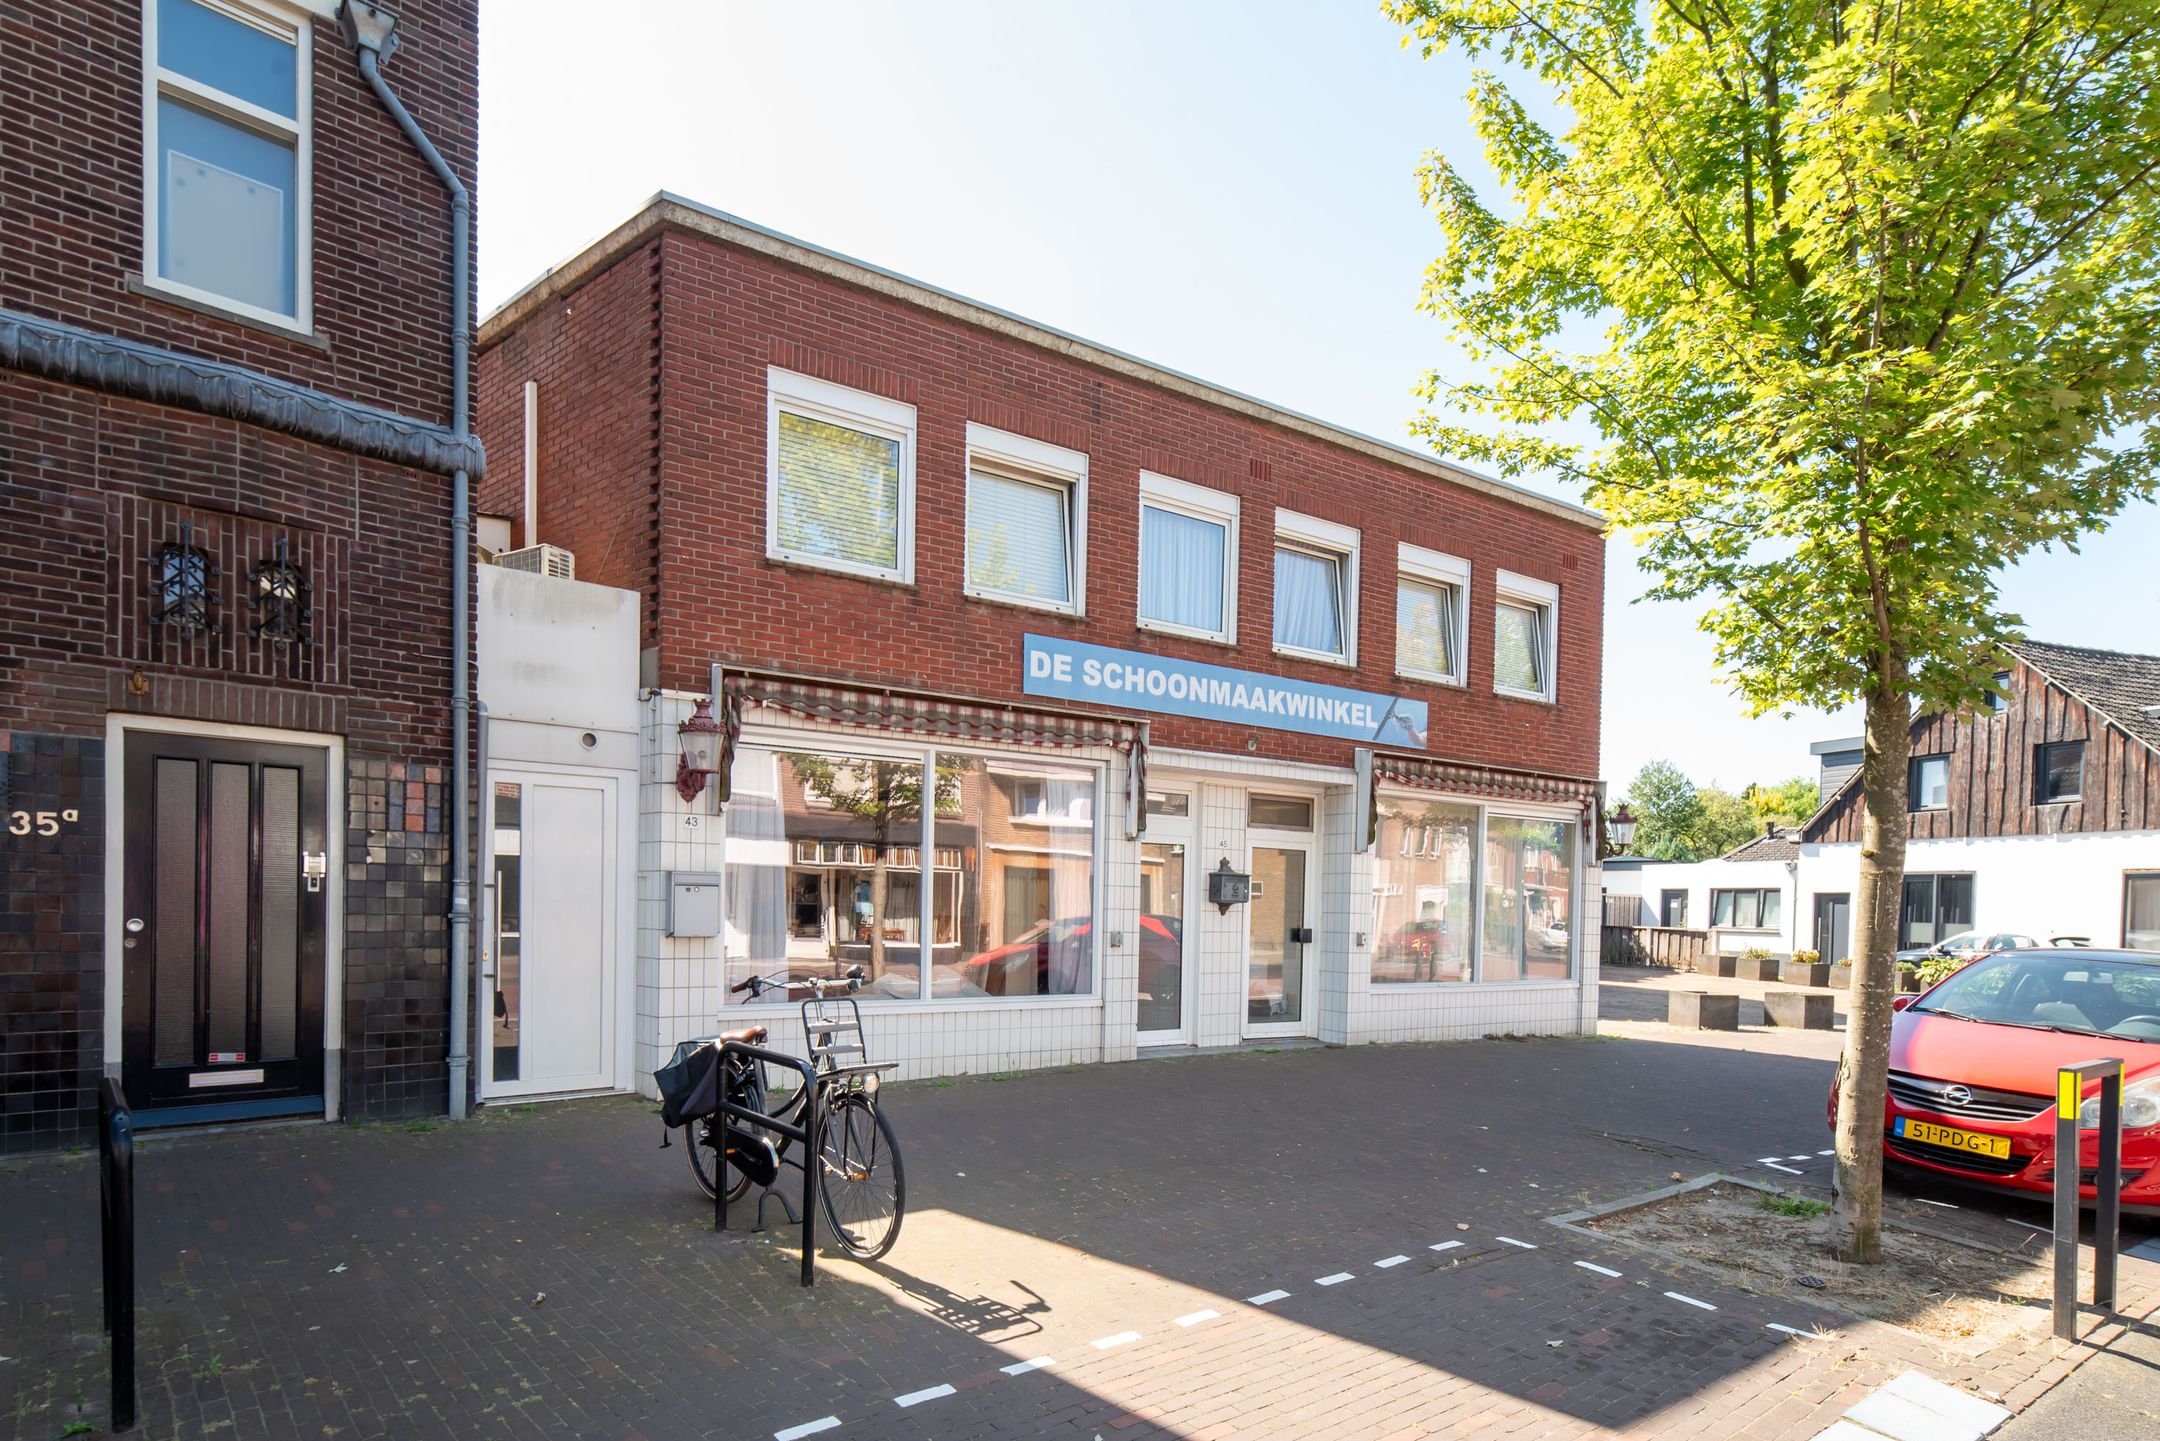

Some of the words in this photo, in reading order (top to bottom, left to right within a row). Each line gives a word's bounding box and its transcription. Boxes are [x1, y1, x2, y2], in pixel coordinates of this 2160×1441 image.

[1030, 650, 1072, 682] DE
[1082, 659, 1378, 728] SCHOONMAAKWINKEL
[685, 816, 698, 827] 43
[1219, 840, 1228, 848] 45
[1913, 1123, 1995, 1153] 51-PDG-1
